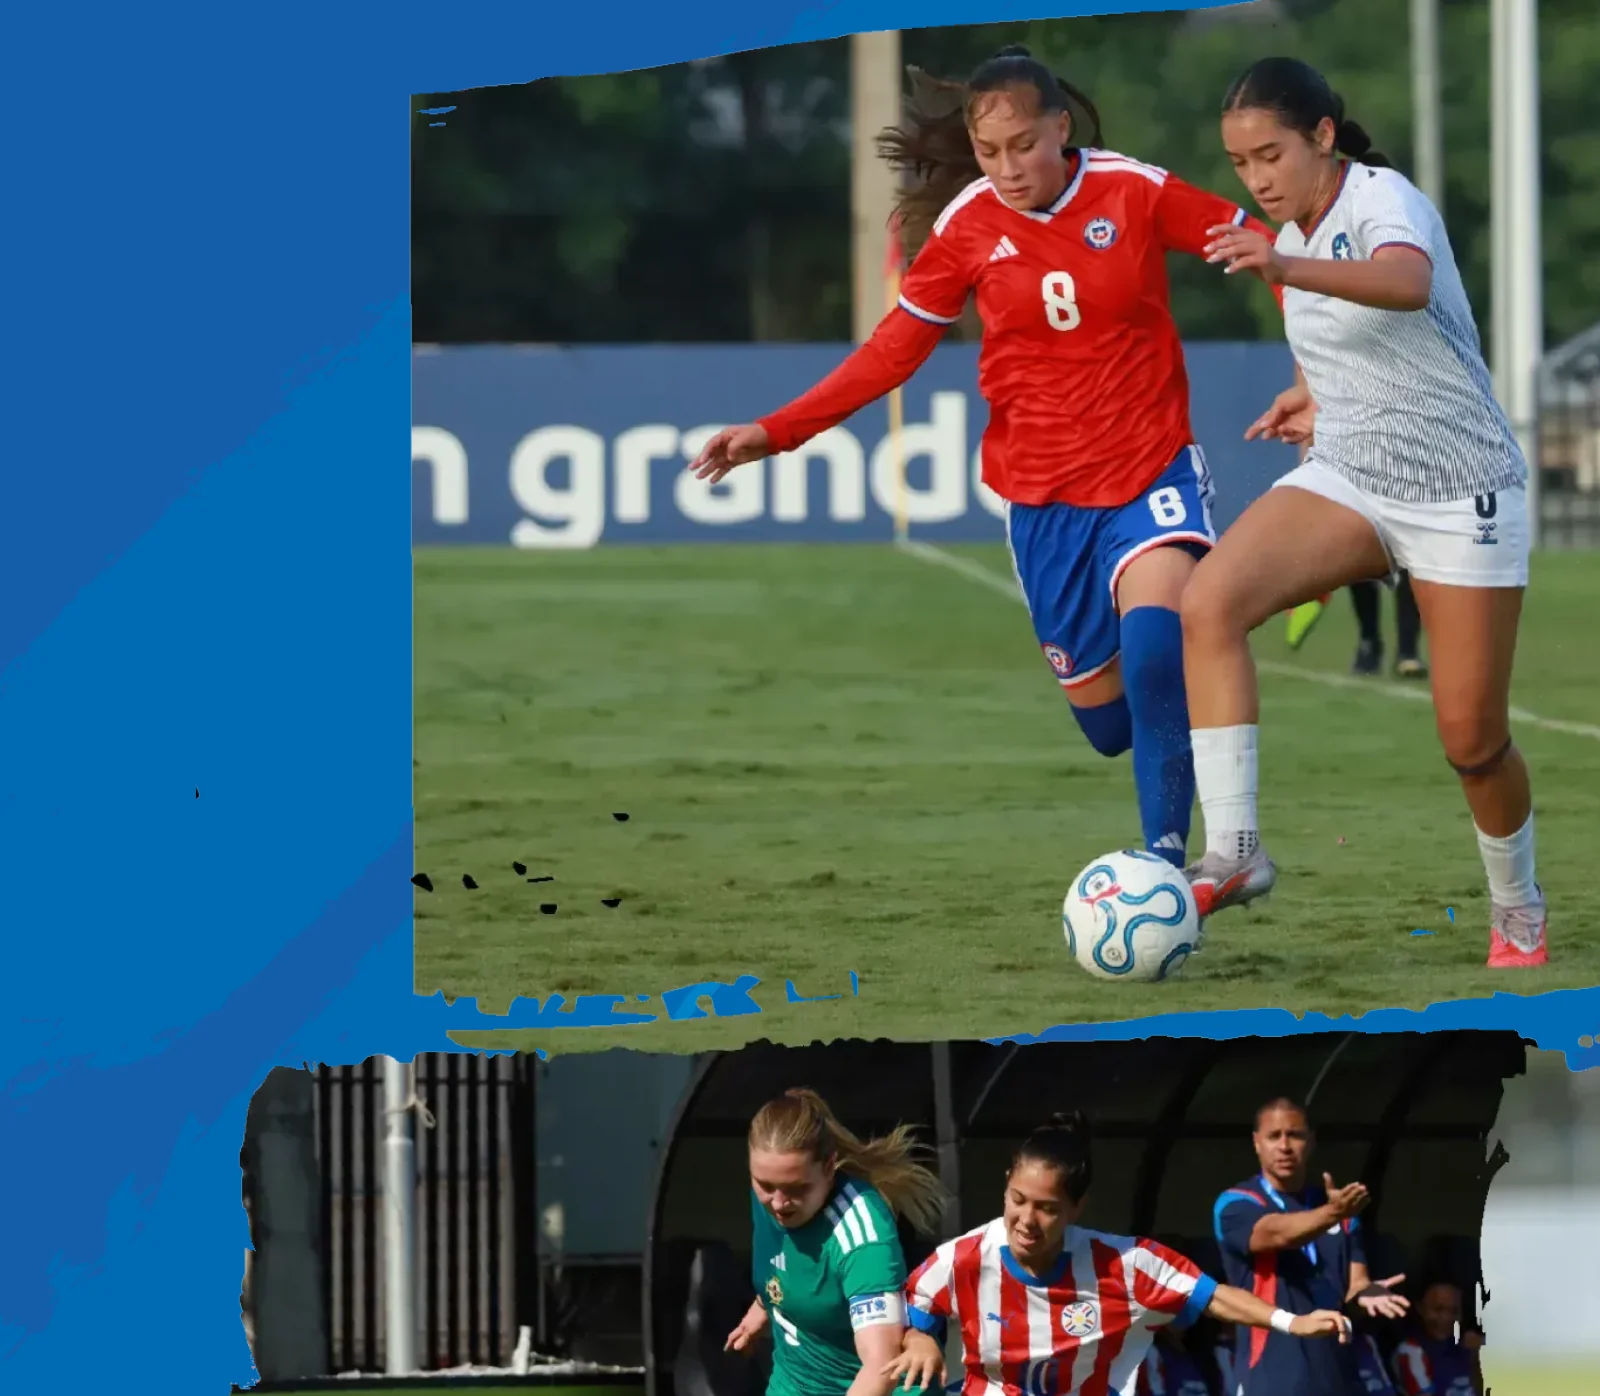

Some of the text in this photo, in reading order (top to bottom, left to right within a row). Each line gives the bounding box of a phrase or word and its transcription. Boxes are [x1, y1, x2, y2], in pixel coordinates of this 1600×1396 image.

[1041, 271, 1081, 331] 8
[509, 391, 1008, 549] grand
[1148, 486, 1187, 527] 8
